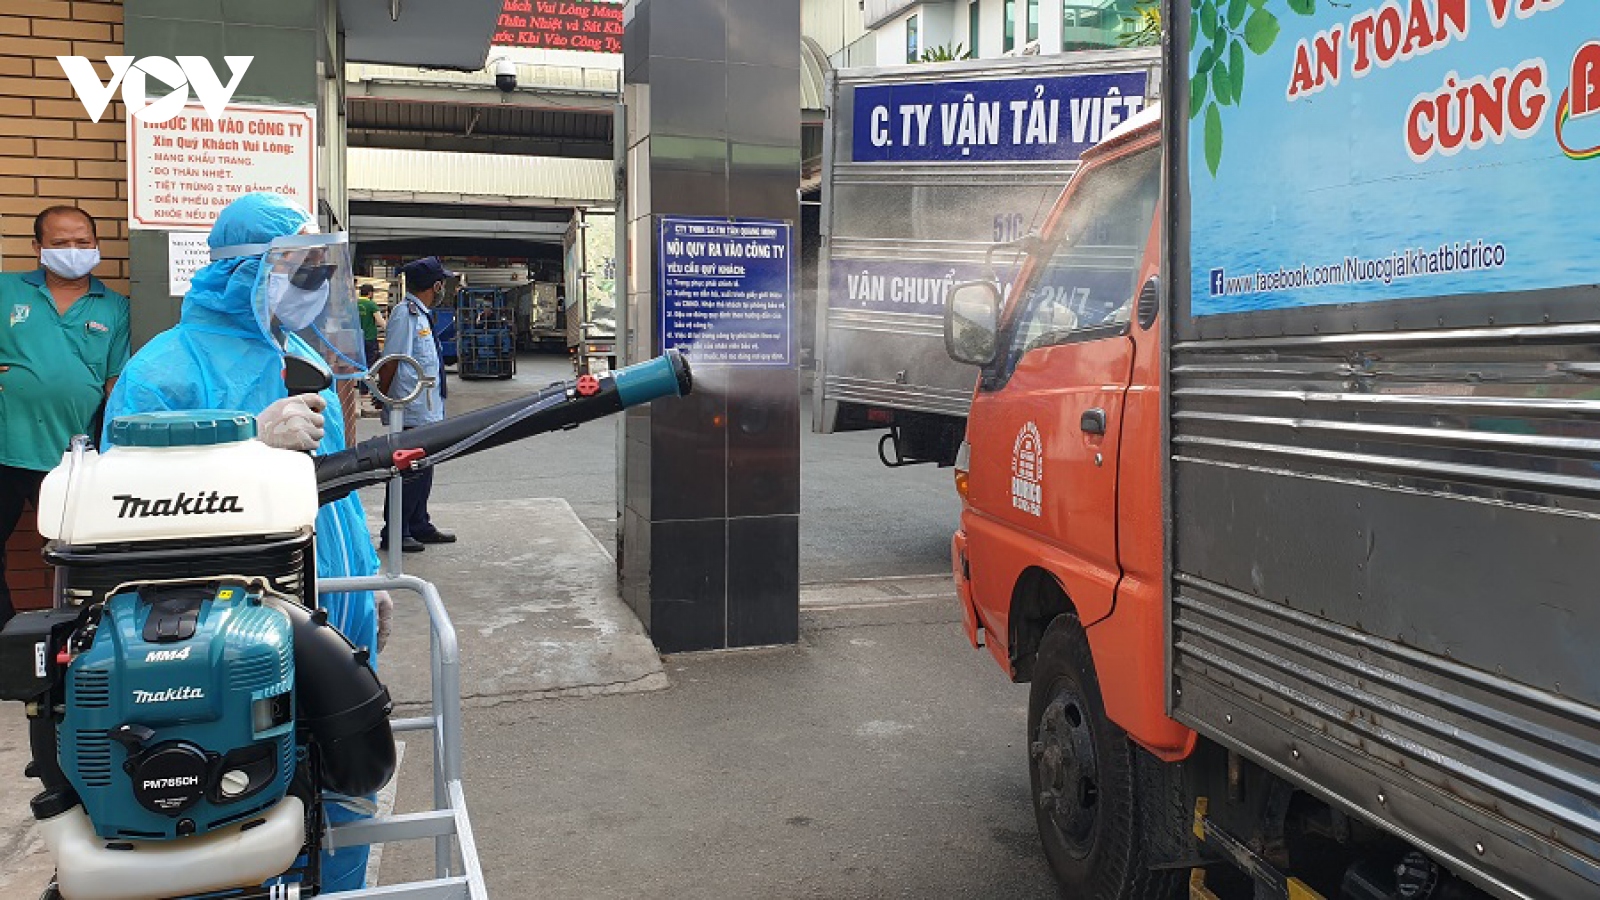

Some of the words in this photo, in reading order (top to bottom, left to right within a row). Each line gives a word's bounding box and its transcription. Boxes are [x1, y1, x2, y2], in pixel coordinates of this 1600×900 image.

[537, 1, 556, 14] Vui
[518, 32, 540, 44] Khi
[544, 34, 567, 46] Vào
[571, 35, 602, 50] Công
[1289, 29, 1341, 95] AN
[191, 117, 214, 133] KHI
[218, 115, 244, 134] VÀO
[248, 119, 285, 137] CÔNG
[288, 122, 303, 137] TY
[870, 106, 892, 147] C.
[900, 105, 932, 146] TY
[941, 93, 1000, 155] VẬN
[1010, 84, 1059, 145] TẢI
[153, 134, 173, 147] Xin
[177, 136, 199, 150] Quý
[202, 137, 239, 150] Khách
[242, 140, 260, 152] Vui
[154, 152, 184, 163] MANG
[667, 238, 684, 258] NỘI
[686, 241, 706, 259] QUY
[708, 243, 722, 256] RA
[723, 240, 743, 257] VÀO
[745, 240, 771, 259] CÔNG
[772, 245, 785, 259] TY
[1225, 239, 1505, 295] www.facebook.com/Nuocgiaikhatbidrico
[848, 270, 884, 306] VẬN
[145, 646, 191, 662] MM4
